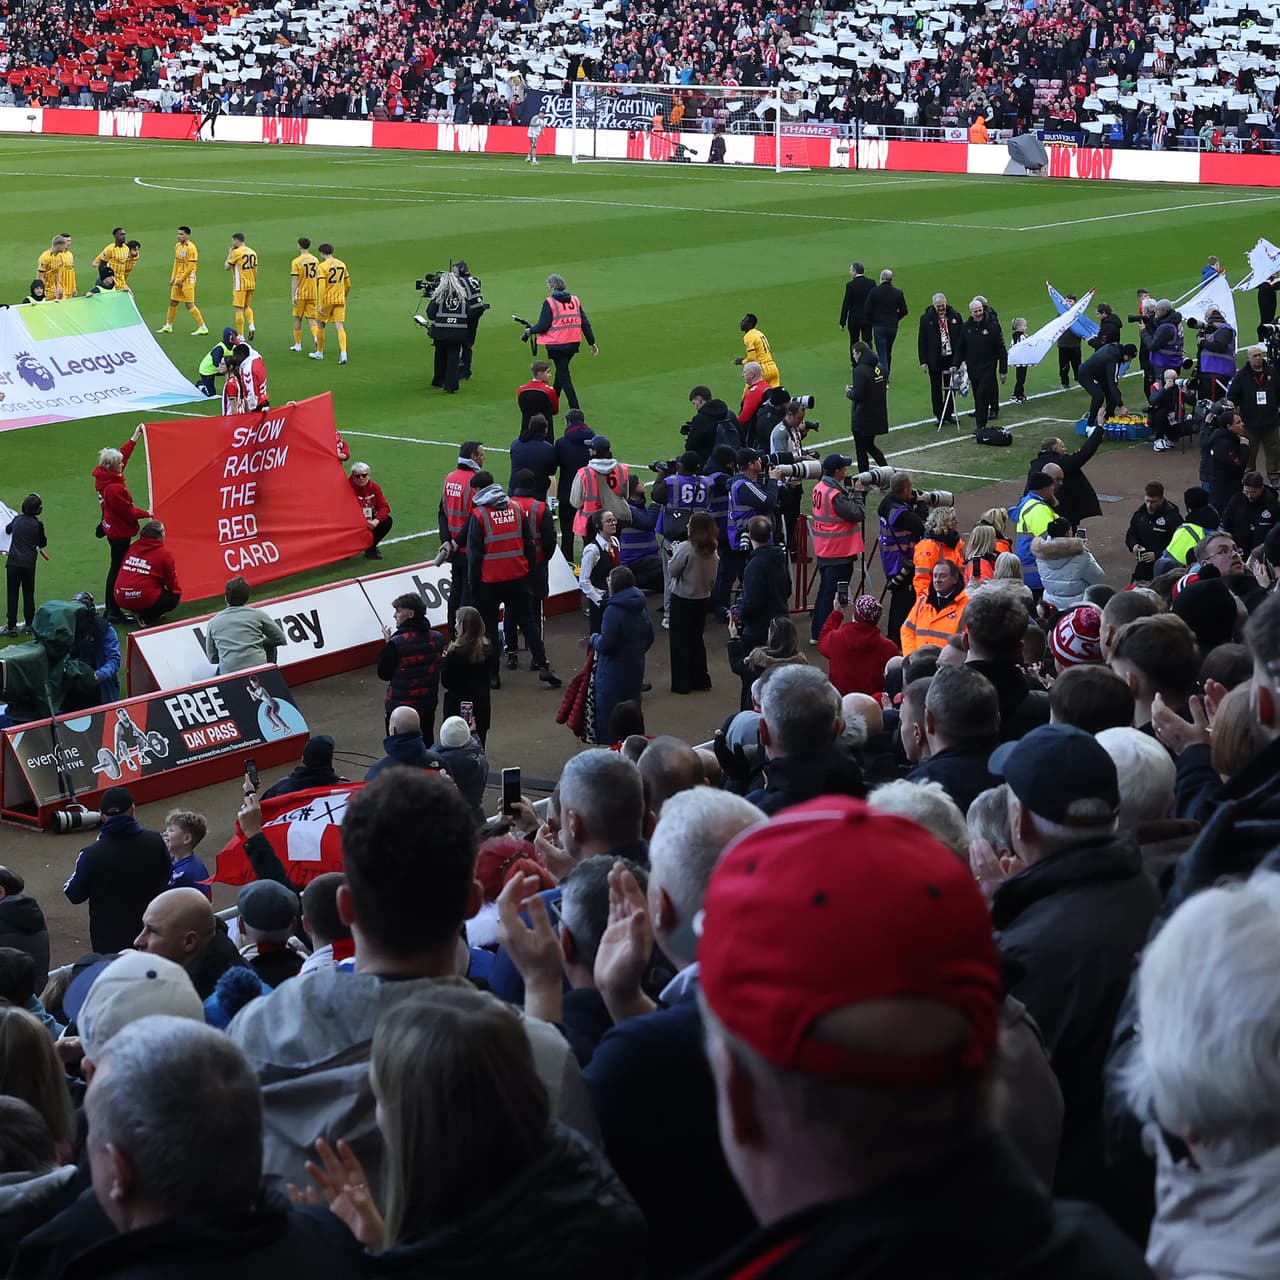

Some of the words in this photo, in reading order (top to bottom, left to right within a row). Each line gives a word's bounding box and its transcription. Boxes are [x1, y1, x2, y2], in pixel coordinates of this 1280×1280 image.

[98, 109, 142, 138] HA'WAY
[262, 116, 308, 145] HA'WAY
[782, 125, 832, 135] THAMES
[436, 124, 489, 152] HA'WAY
[1050, 145, 1113, 179] HA'WAY
[241, 254, 256, 270] 20
[303, 262, 316, 279] 13
[328, 266, 344, 283] 27
[49, 348, 138, 377] League
[26, 394, 69, 410] than
[69, 396, 82, 405] a
[86, 386, 137, 404] game.
[231, 417, 286, 448] SHOW
[223, 445, 289, 478] RACISM
[220, 482, 257, 510] THE
[446, 482, 463, 491] PITCH
[446, 489, 463, 498] TEAM
[682, 483, 706, 504] 66
[218, 513, 258, 542] RED
[489, 509, 515, 519] PITCH
[492, 516, 516, 525] TEAM
[224, 541, 280, 572] CARD
[165, 687, 230, 730] FREE
[184, 732, 208, 749] DAY
[209, 722, 238, 743] PASS
[27, 743, 80, 769] everyone
